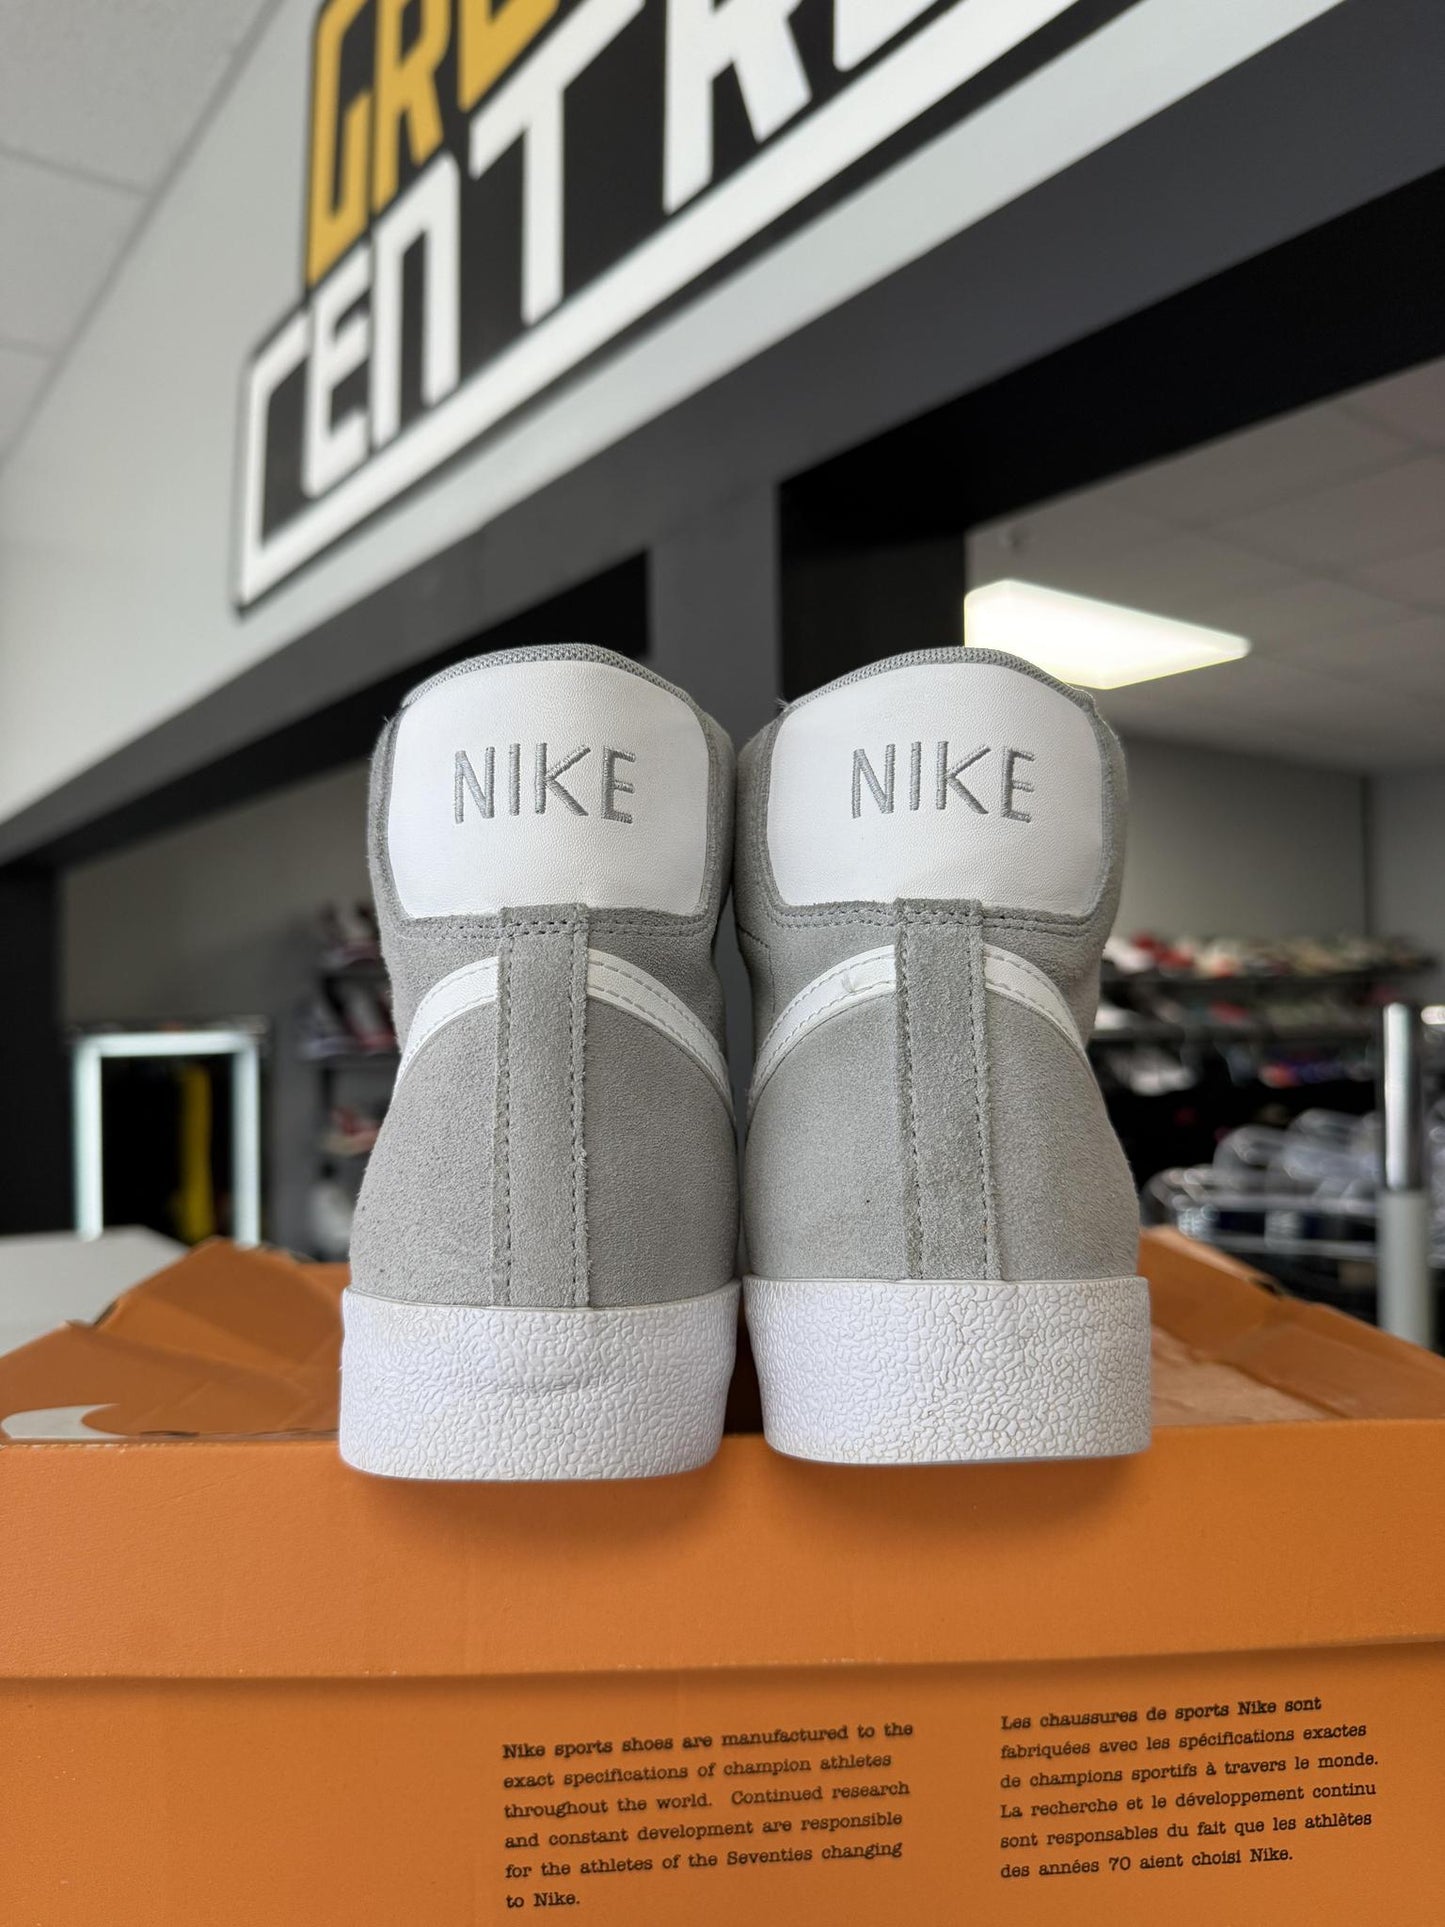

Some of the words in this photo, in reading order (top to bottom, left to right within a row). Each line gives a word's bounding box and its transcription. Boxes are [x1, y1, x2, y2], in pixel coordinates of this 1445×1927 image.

[236, 0, 940, 608] CENTR
[453, 741, 636, 825] NIKE
[851, 739, 1035, 824] NIKE
[1000, 1715, 1032, 1732] Les
[1039, 1710, 1139, 1729] chaussures
[1145, 1706, 1168, 1723] de
[1174, 1703, 1231, 1723] sports
[1236, 1699, 1278, 1717] Nike
[1284, 1696, 1323, 1713] sont
[501, 1742, 547, 1761] Nike
[553, 1739, 614, 1760] sports
[620, 1736, 675, 1755] shoes
[681, 1735, 714, 1752] are
[720, 1724, 850, 1748] manufactured
[856, 1724, 876, 1740] to
[883, 1722, 914, 1739] the
[1000, 1740, 1091, 1761] fabriquées
[1098, 1739, 1139, 1755] avec
[1145, 1736, 1171, 1752] les
[1177, 1728, 1296, 1752] spécifications
[1302, 1723, 1367, 1741] exactes
[502, 1772, 556, 1790] exact
[562, 1766, 689, 1790] specifications
[696, 1761, 717, 1779] of
[722, 1758, 812, 1777] champion
[819, 1754, 893, 1772] athletes
[999, 1774, 1022, 1790] de
[1029, 1769, 1124, 1789] champions
[1130, 1762, 1198, 1785] sportifs
[1205, 1761, 1218, 1777] à
[1223, 1759, 1287, 1776] travers
[1293, 1755, 1310, 1771] le
[1316, 1751, 1379, 1770] monde.
[503, 1799, 609, 1820] throughout
[616, 1797, 648, 1814] the
[655, 1792, 713, 1811] world.
[730, 1785, 824, 1807] Continued
[831, 1780, 911, 1801] research
[999, 1804, 1024, 1820] La
[1030, 1797, 1119, 1818] recherche
[1125, 1796, 1144, 1811] et
[1150, 1794, 1168, 1810] le
[1174, 1785, 1305, 1809] développement
[1311, 1782, 1377, 1800] continu
[504, 1832, 541, 1850] and
[548, 1828, 630, 1847] constant
[636, 1820, 755, 1843] development
[761, 1820, 793, 1835] are
[800, 1811, 903, 1834] responsible
[999, 1832, 1039, 1850] sont
[1045, 1825, 1159, 1848] responsables
[1166, 1822, 1190, 1839] du
[1196, 1820, 1227, 1837] fait
[1233, 1820, 1265, 1838] que
[1272, 1816, 1297, 1832] les
[1303, 1812, 1373, 1830] athlètes
[504, 1863, 533, 1880] for
[539, 1861, 572, 1878] the
[579, 1857, 654, 1876] athletes
[661, 1853, 682, 1870] of
[687, 1852, 719, 1869] the
[726, 1847, 814, 1866] Seventies
[821, 1841, 903, 1861] changing
[1000, 1863, 1031, 1879] des
[1038, 1858, 1100, 1877] années
[1108, 1855, 1132, 1872] 70
[1138, 1853, 1185, 1871] aient
[1191, 1849, 1243, 1867] choisi
[1249, 1846, 1294, 1863] Nike.
[505, 1894, 525, 1910] to
[532, 1891, 581, 1908] Nike.
